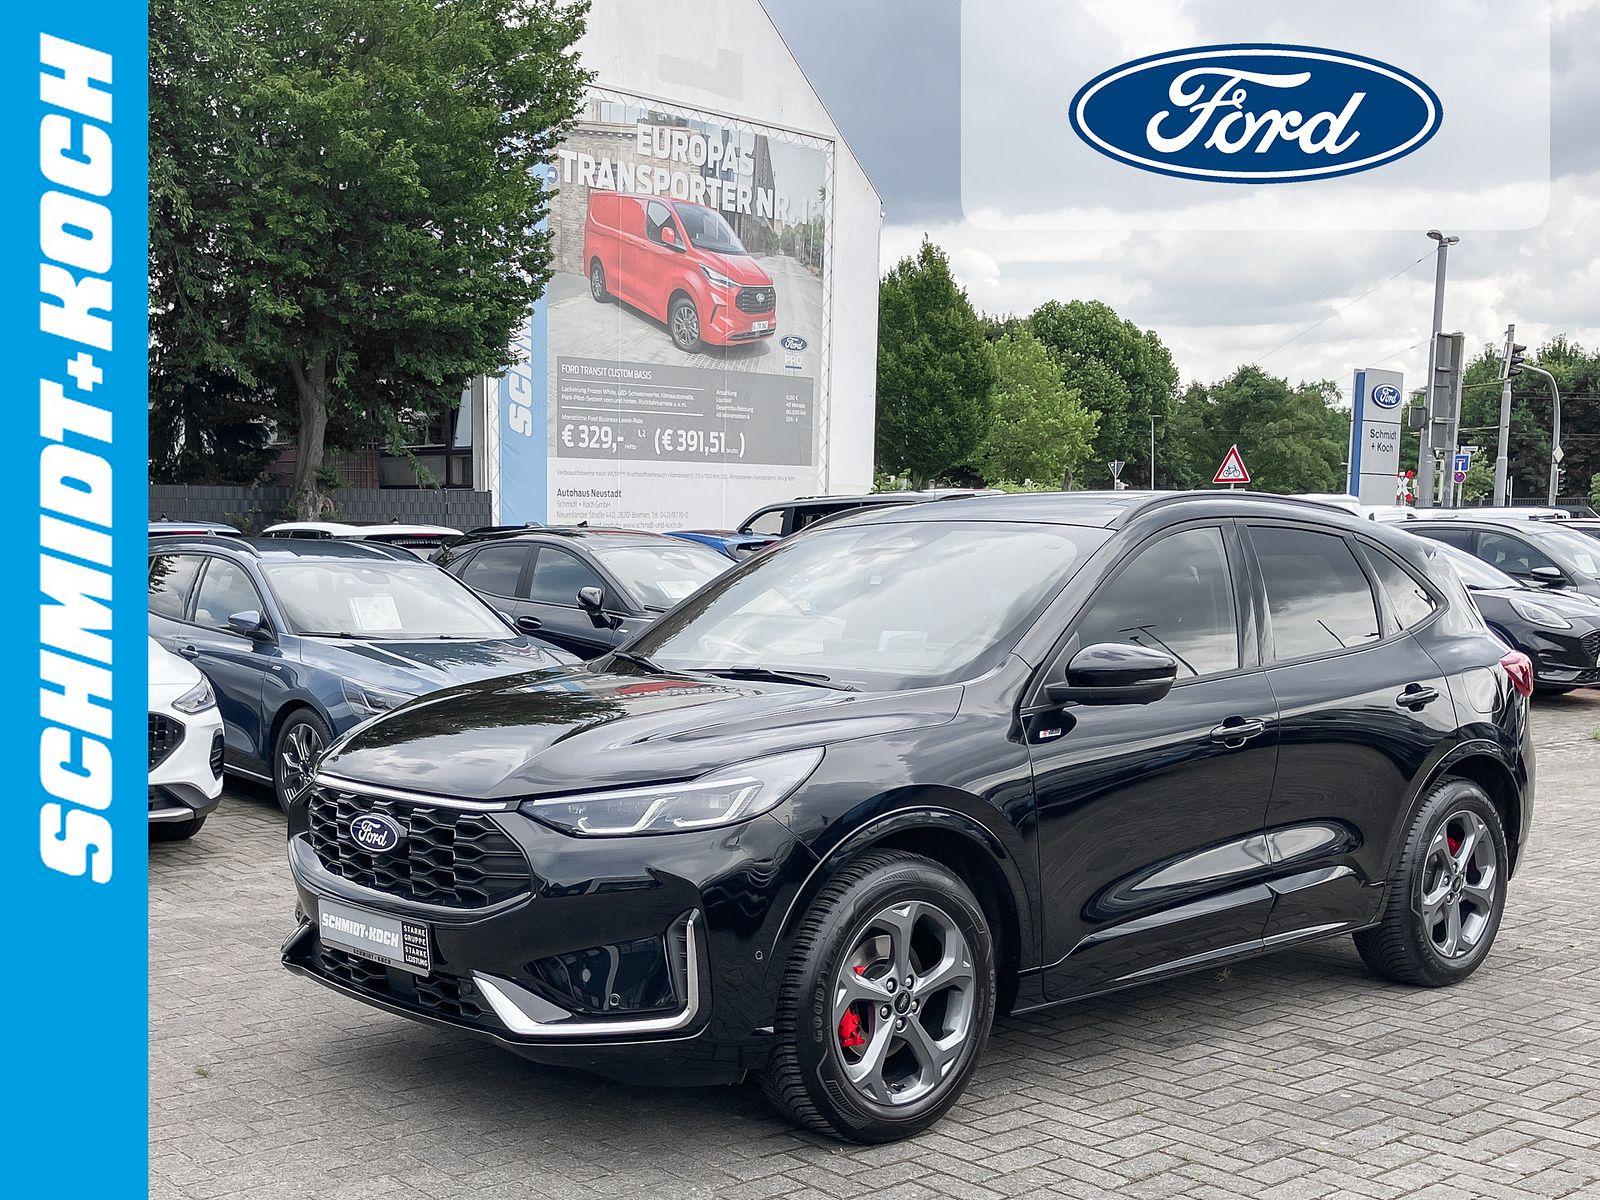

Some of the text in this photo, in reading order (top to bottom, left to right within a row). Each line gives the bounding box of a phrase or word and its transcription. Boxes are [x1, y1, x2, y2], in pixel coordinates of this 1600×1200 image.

[637, 123, 755, 176] EUROPAS
[559, 150, 752, 215] TRANSPORTER
[785, 337, 803, 350] Ford
[784, 355, 802, 365] PRO
[561, 364, 652, 380] FORD TRANSIT CUSTOM BASIS
[1380, 387, 1398, 404] Ford
[561, 424, 575, 448] €
[578, 425, 625, 453] 329,-
[1370, 428, 1397, 440] Schmidt
[677, 429, 725, 456] 391,51
[1377, 442, 1394, 452] Koch
[556, 488, 622, 498] Autohaus Neustadt
[557, 500, 578, 508] Schmidt
[583, 501, 595, 509] Koch
[358, 821, 388, 847] Ford
[403, 925, 426, 937] STARKE
[404, 934, 426, 946] GRUPPE
[405, 946, 427, 958] STARKE
[405, 955, 428, 967] LEISTUNG
